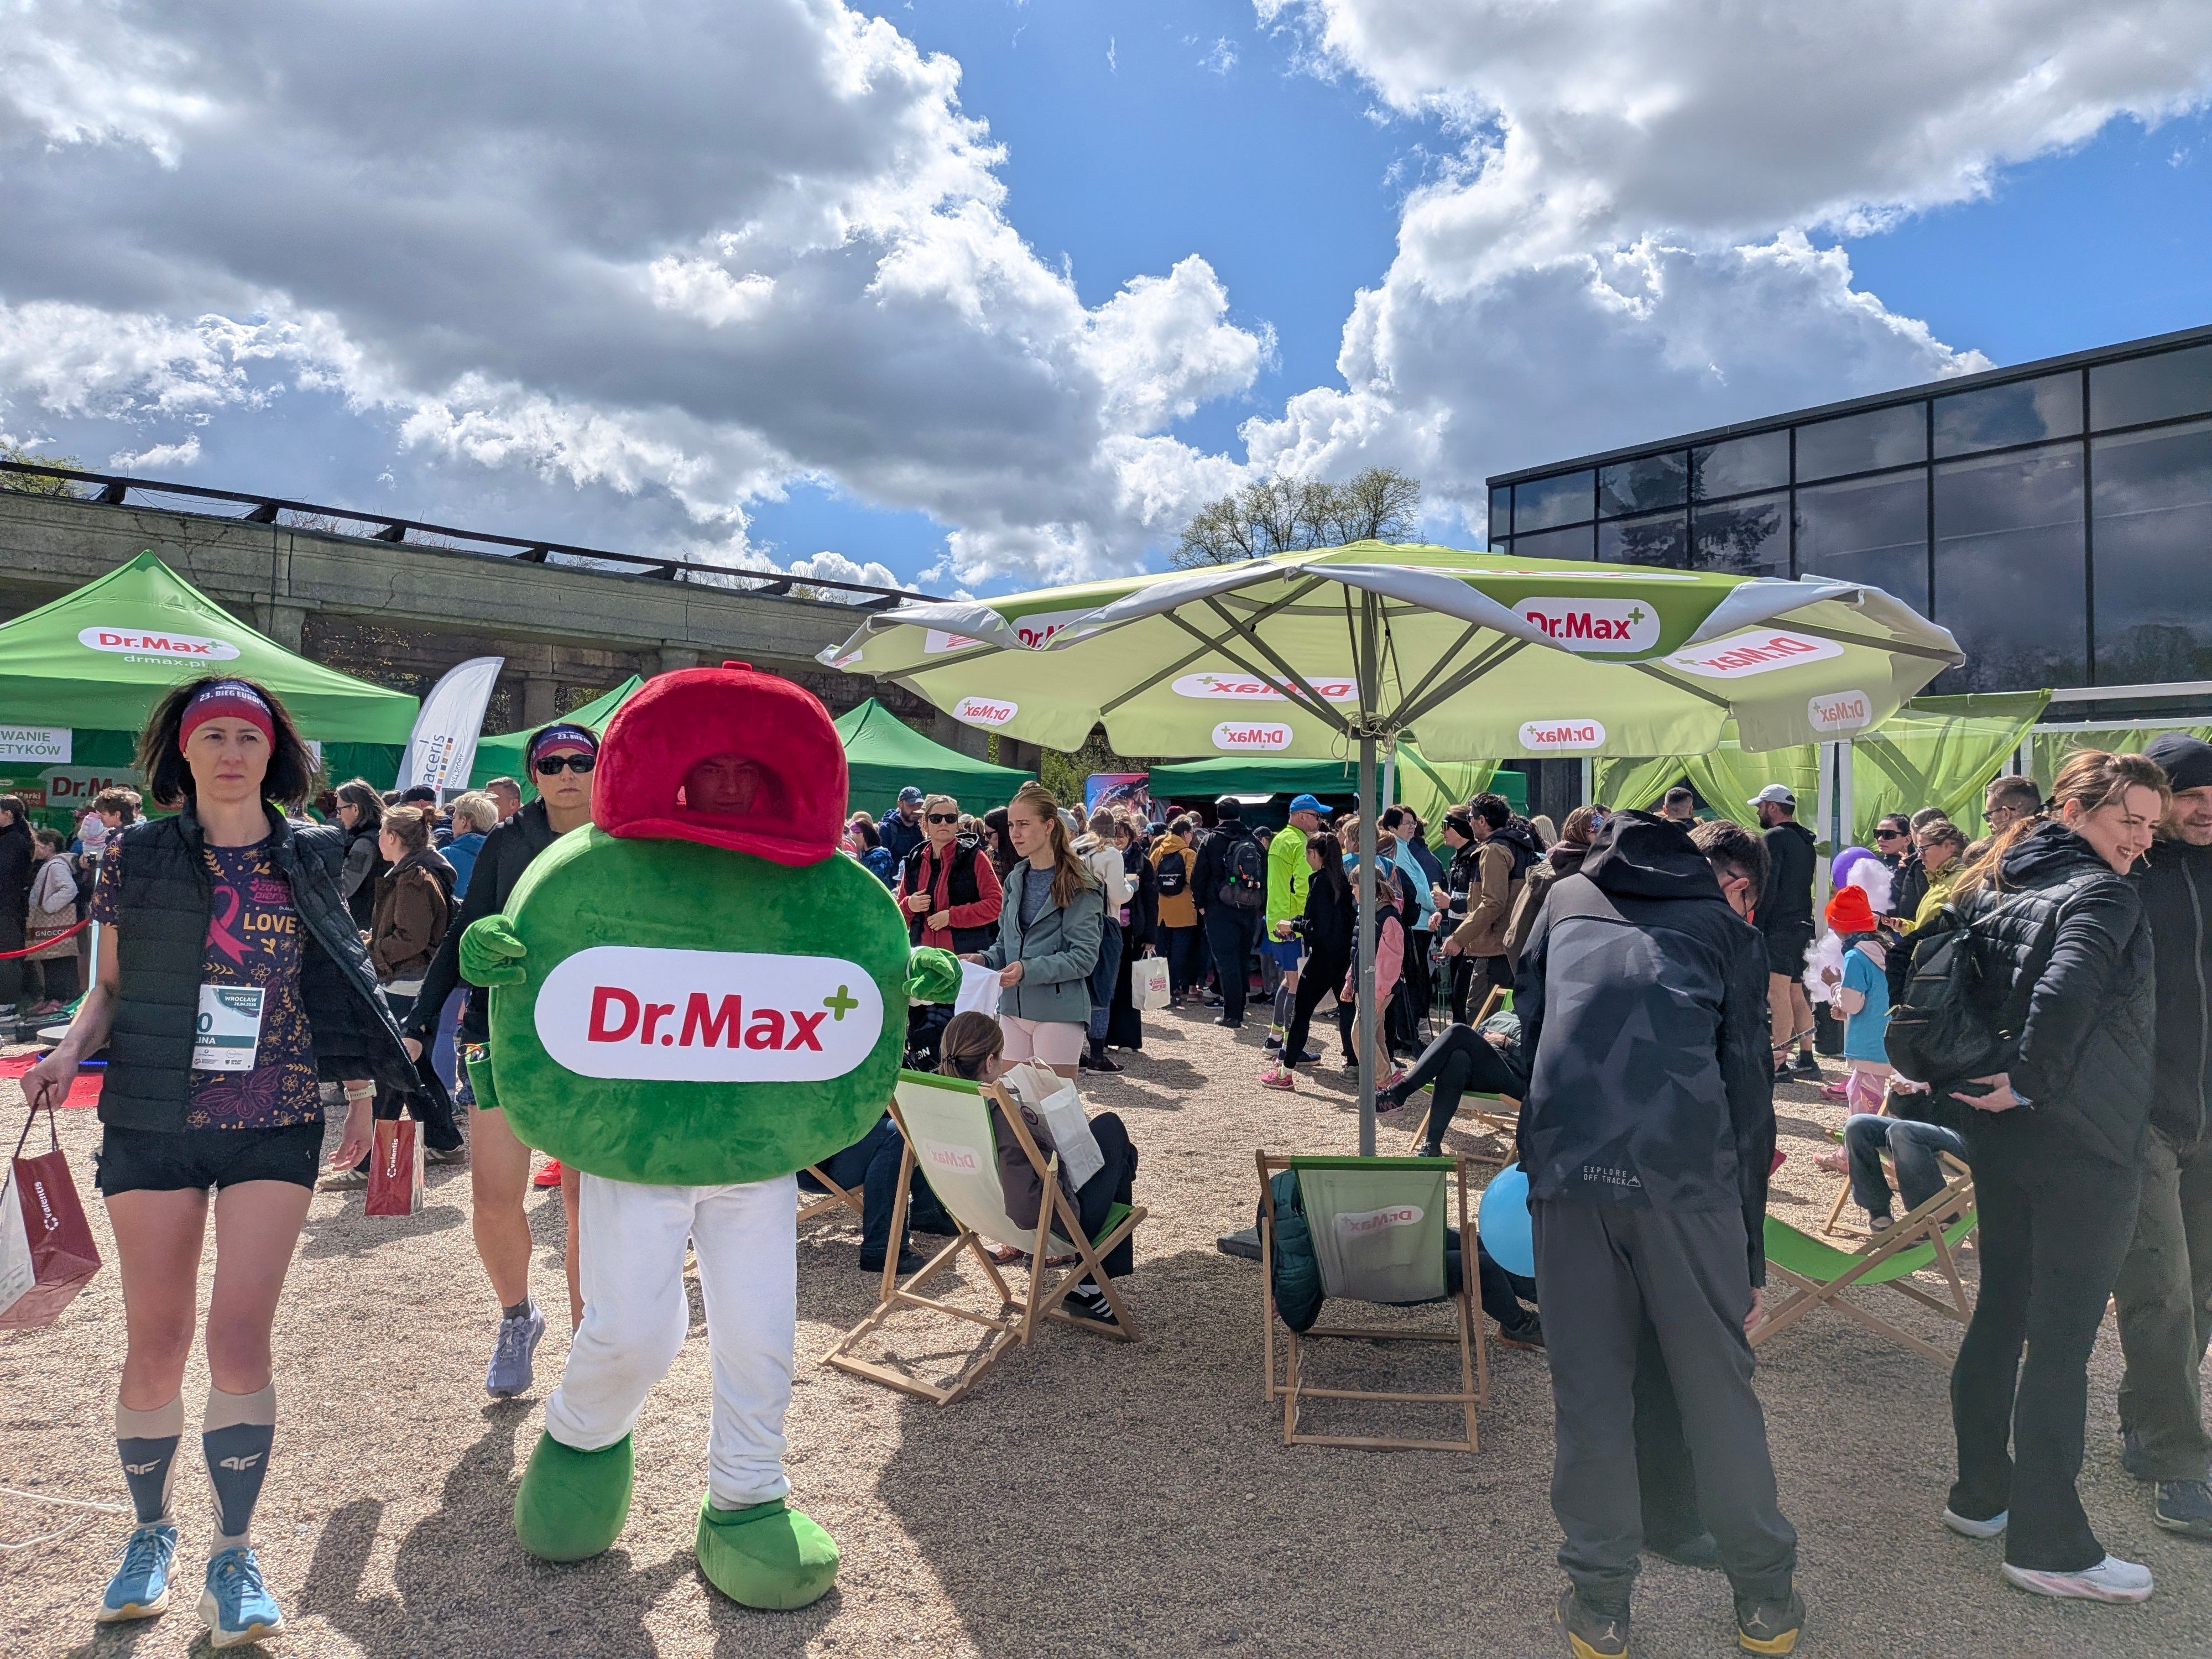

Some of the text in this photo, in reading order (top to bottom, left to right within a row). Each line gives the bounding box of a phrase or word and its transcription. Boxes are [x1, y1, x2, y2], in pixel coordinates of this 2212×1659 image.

[124, 655, 205, 667] drmax.pl
[199, 692, 213, 702] 23.
[419, 734, 445, 788] aceris
[454, 753, 464, 773] SKÓRY
[243, 912, 297, 934] LOVE
[1584, 1166, 1627, 1178] EXPLORE
[1602, 1175, 1626, 1185] TRACK
